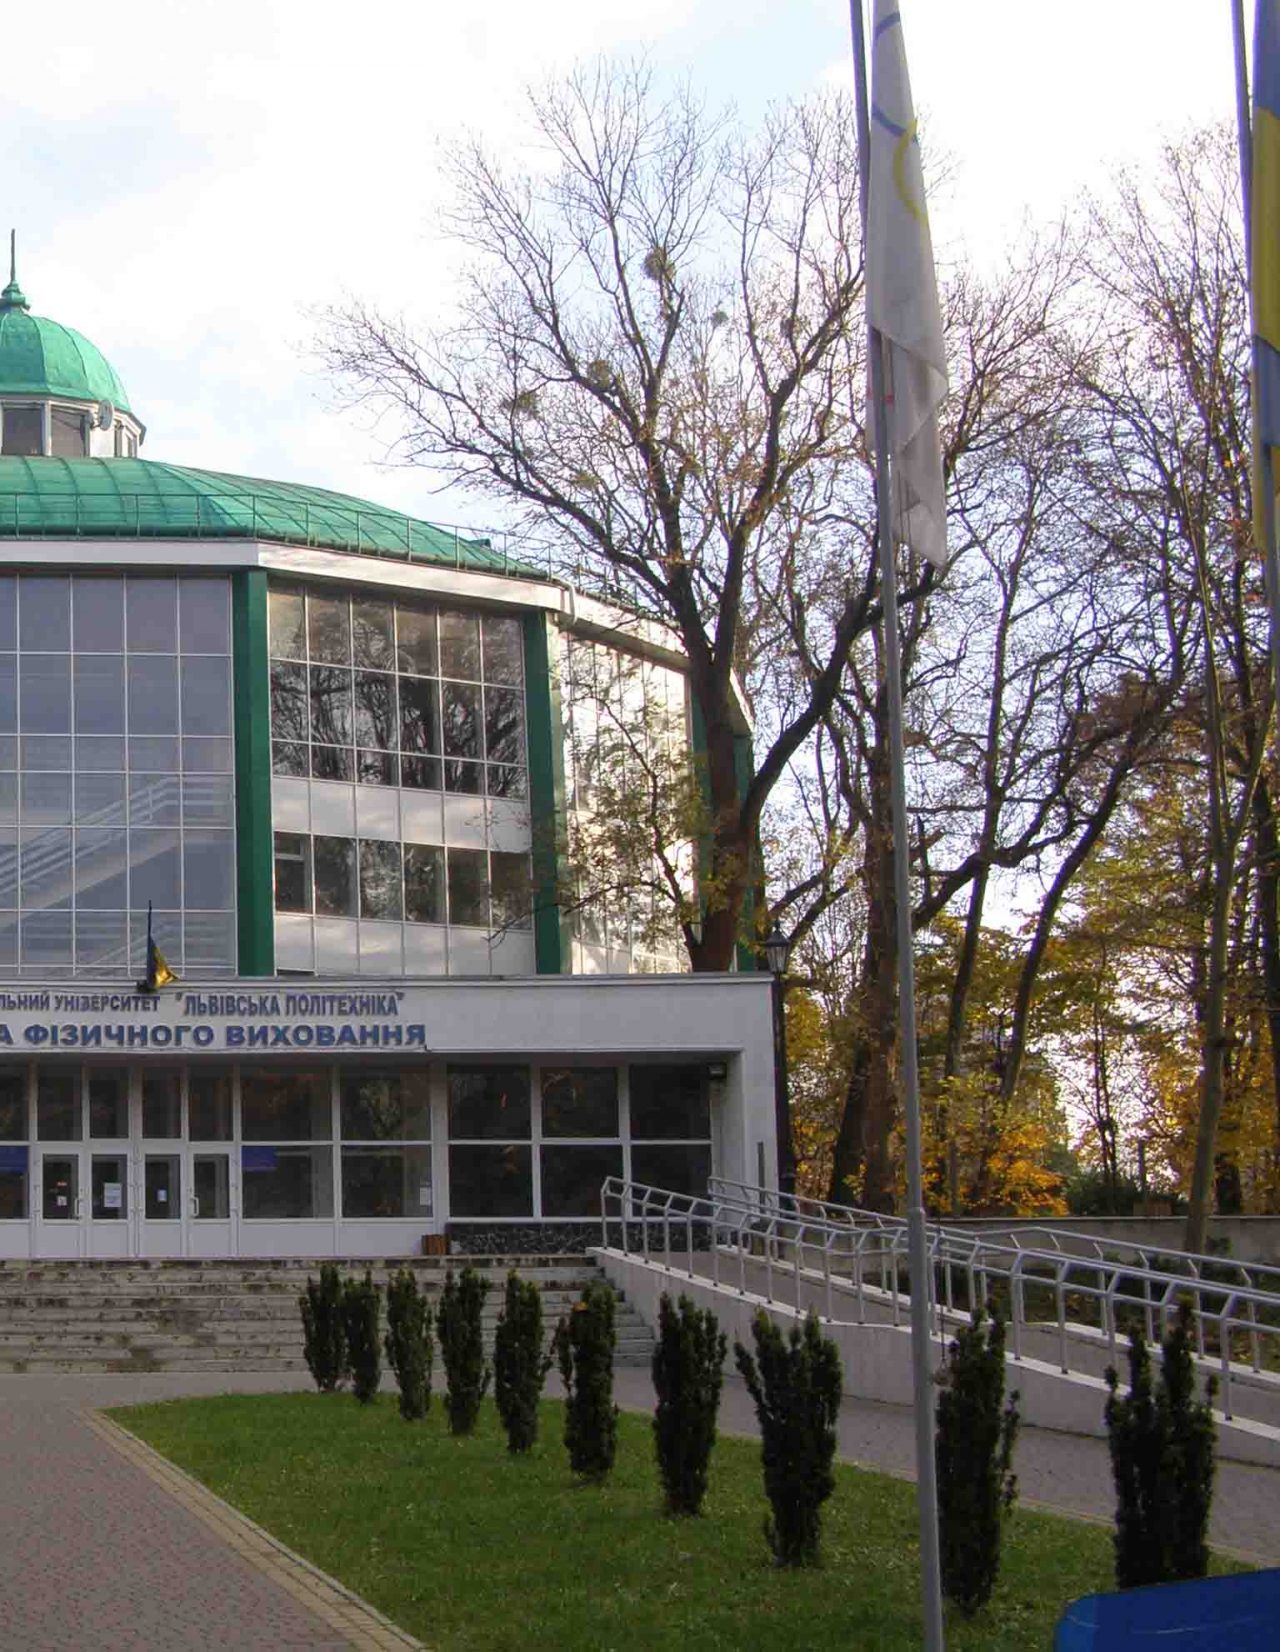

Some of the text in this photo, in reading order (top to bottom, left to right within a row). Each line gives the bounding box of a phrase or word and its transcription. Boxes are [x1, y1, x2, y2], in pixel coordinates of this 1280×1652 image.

[54, 993, 161, 1013] УНІВЕРСИТЕТ
[23, 1022, 215, 1046] ФІЗИЧНОГО
[225, 1023, 426, 1046] ВИХОВАННЯ
